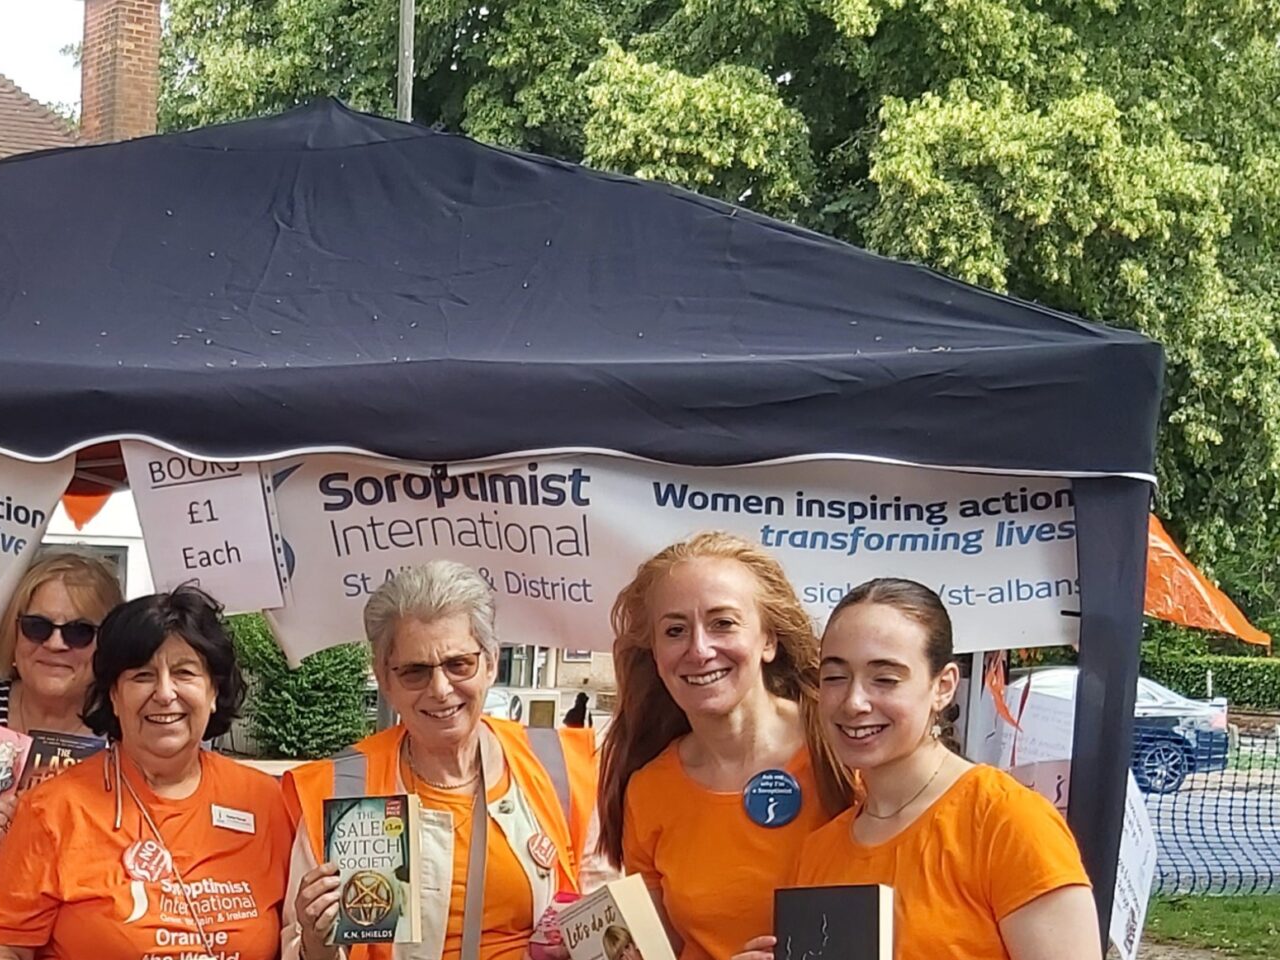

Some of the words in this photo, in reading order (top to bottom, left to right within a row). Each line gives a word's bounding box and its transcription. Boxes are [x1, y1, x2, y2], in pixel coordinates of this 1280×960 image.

[319, 462, 590, 511] Soroptimist
[187, 499, 219, 525] £1
[653, 482, 783, 516] Women
[796, 490, 948, 526] inspiring
[960, 487, 1075, 519] action
[330, 510, 590, 557] International
[760, 524, 984, 556] transforming
[996, 519, 1076, 548] lives
[182, 540, 241, 569] Each
[505, 571, 593, 603] District
[357, 811, 375, 820] THE
[336, 820, 386, 839] SALE
[334, 838, 400, 855] WITCH
[339, 856, 396, 870] SOCIETY
[159, 894, 257, 915] Intenational
[361, 930, 393, 939] SHIELDS
[591, 913, 604, 933] do
